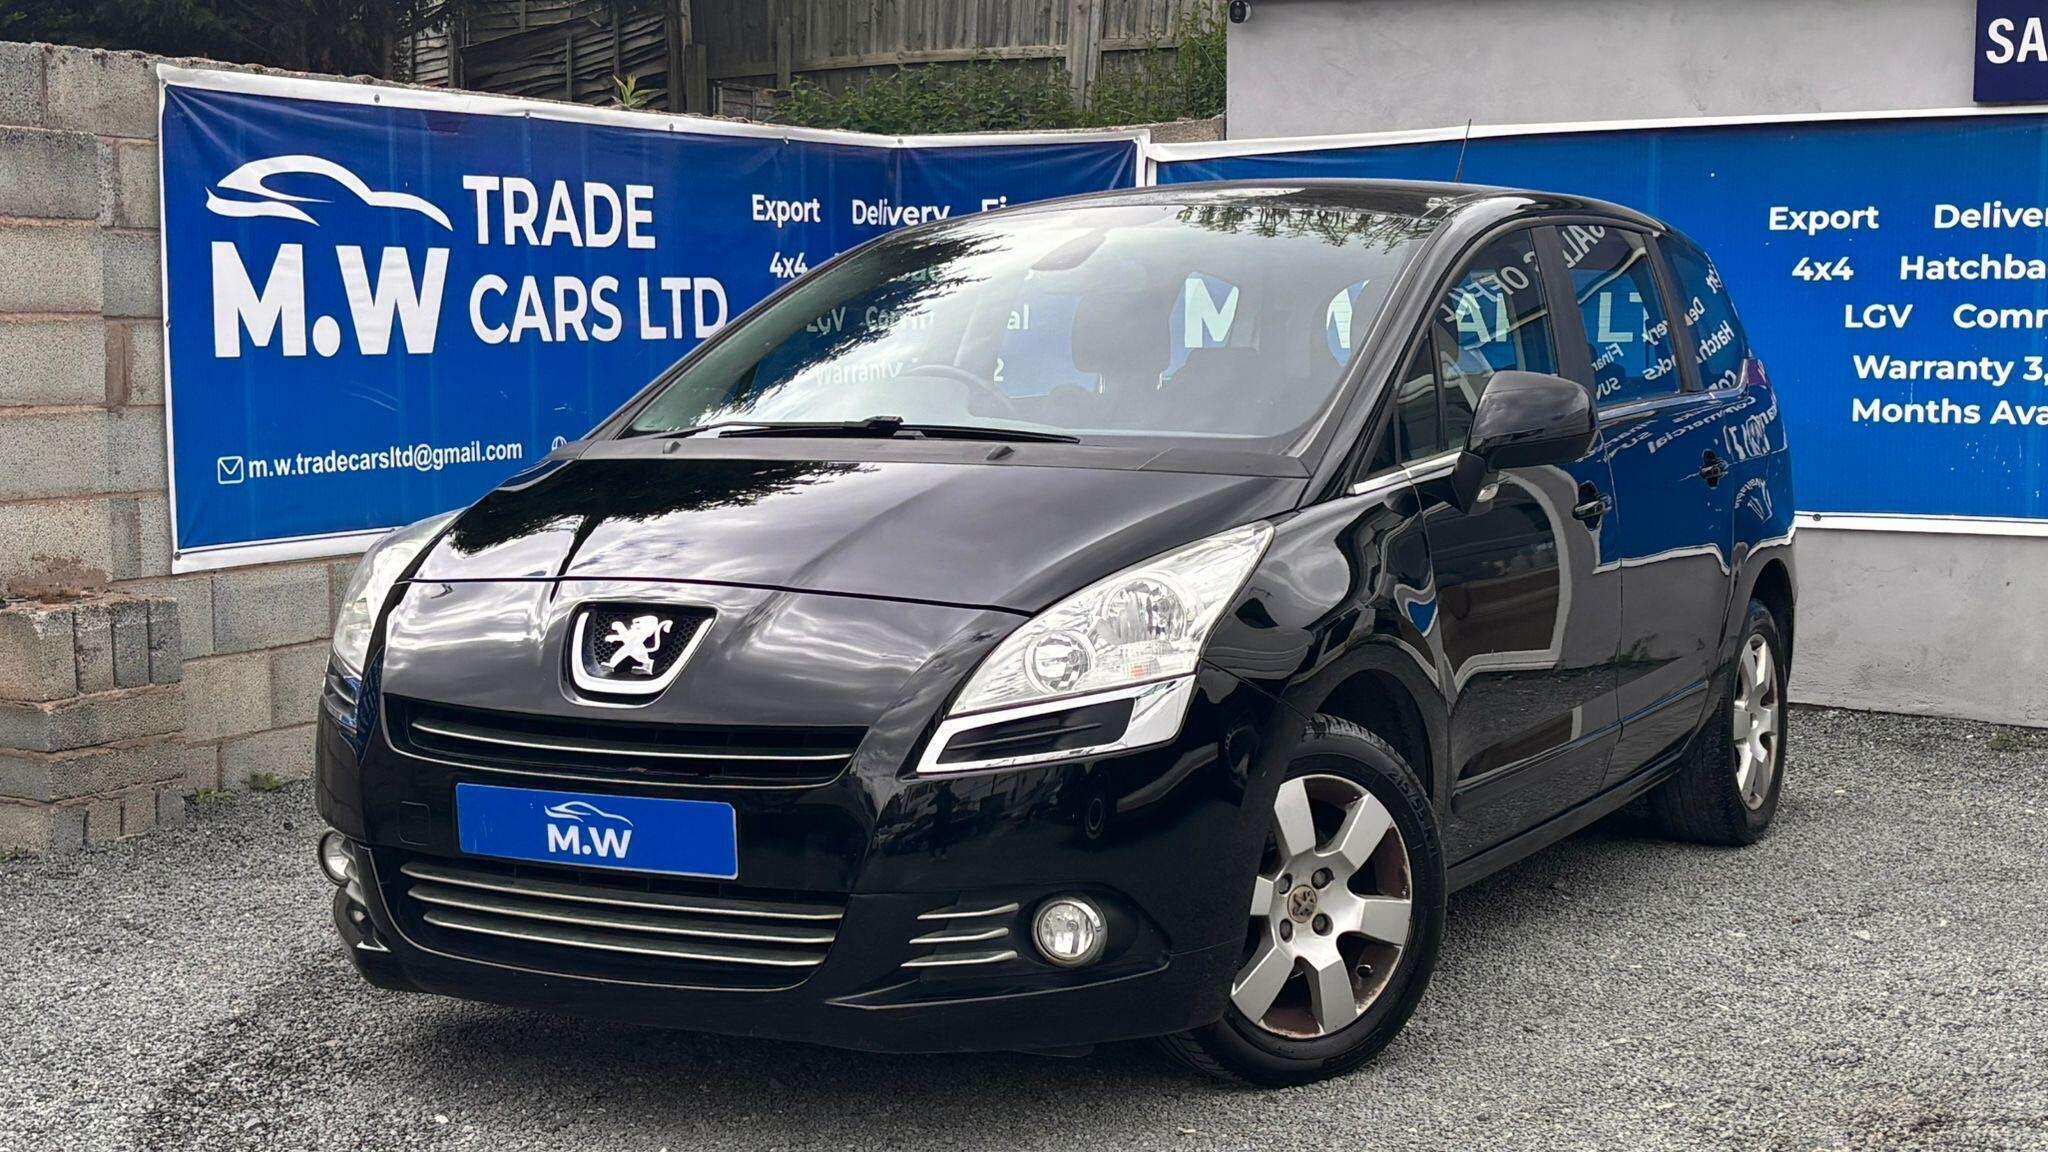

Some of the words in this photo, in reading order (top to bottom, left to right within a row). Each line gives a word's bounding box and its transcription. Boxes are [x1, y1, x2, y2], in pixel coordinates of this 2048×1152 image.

[1986, 17, 2048, 64] SA
[463, 175, 655, 249] TRADE
[752, 194, 821, 229] Export
[1769, 206, 1879, 236] Export
[1934, 200, 2048, 229] Delive
[769, 252, 808, 278] 4x4
[1792, 256, 1854, 281] 4x4
[211, 241, 450, 358] M.W
[469, 274, 622, 344] CARS
[638, 277, 727, 340] LTD
[1845, 303, 1914, 329] LGV
[1853, 355, 2014, 387] Warranty
[2022, 356, 2048, 386] 3,
[1852, 398, 1981, 424] Months
[248, 440, 523, 478] m.w.tradecarsltd@gmail.com
[547, 823, 632, 860] M.W
